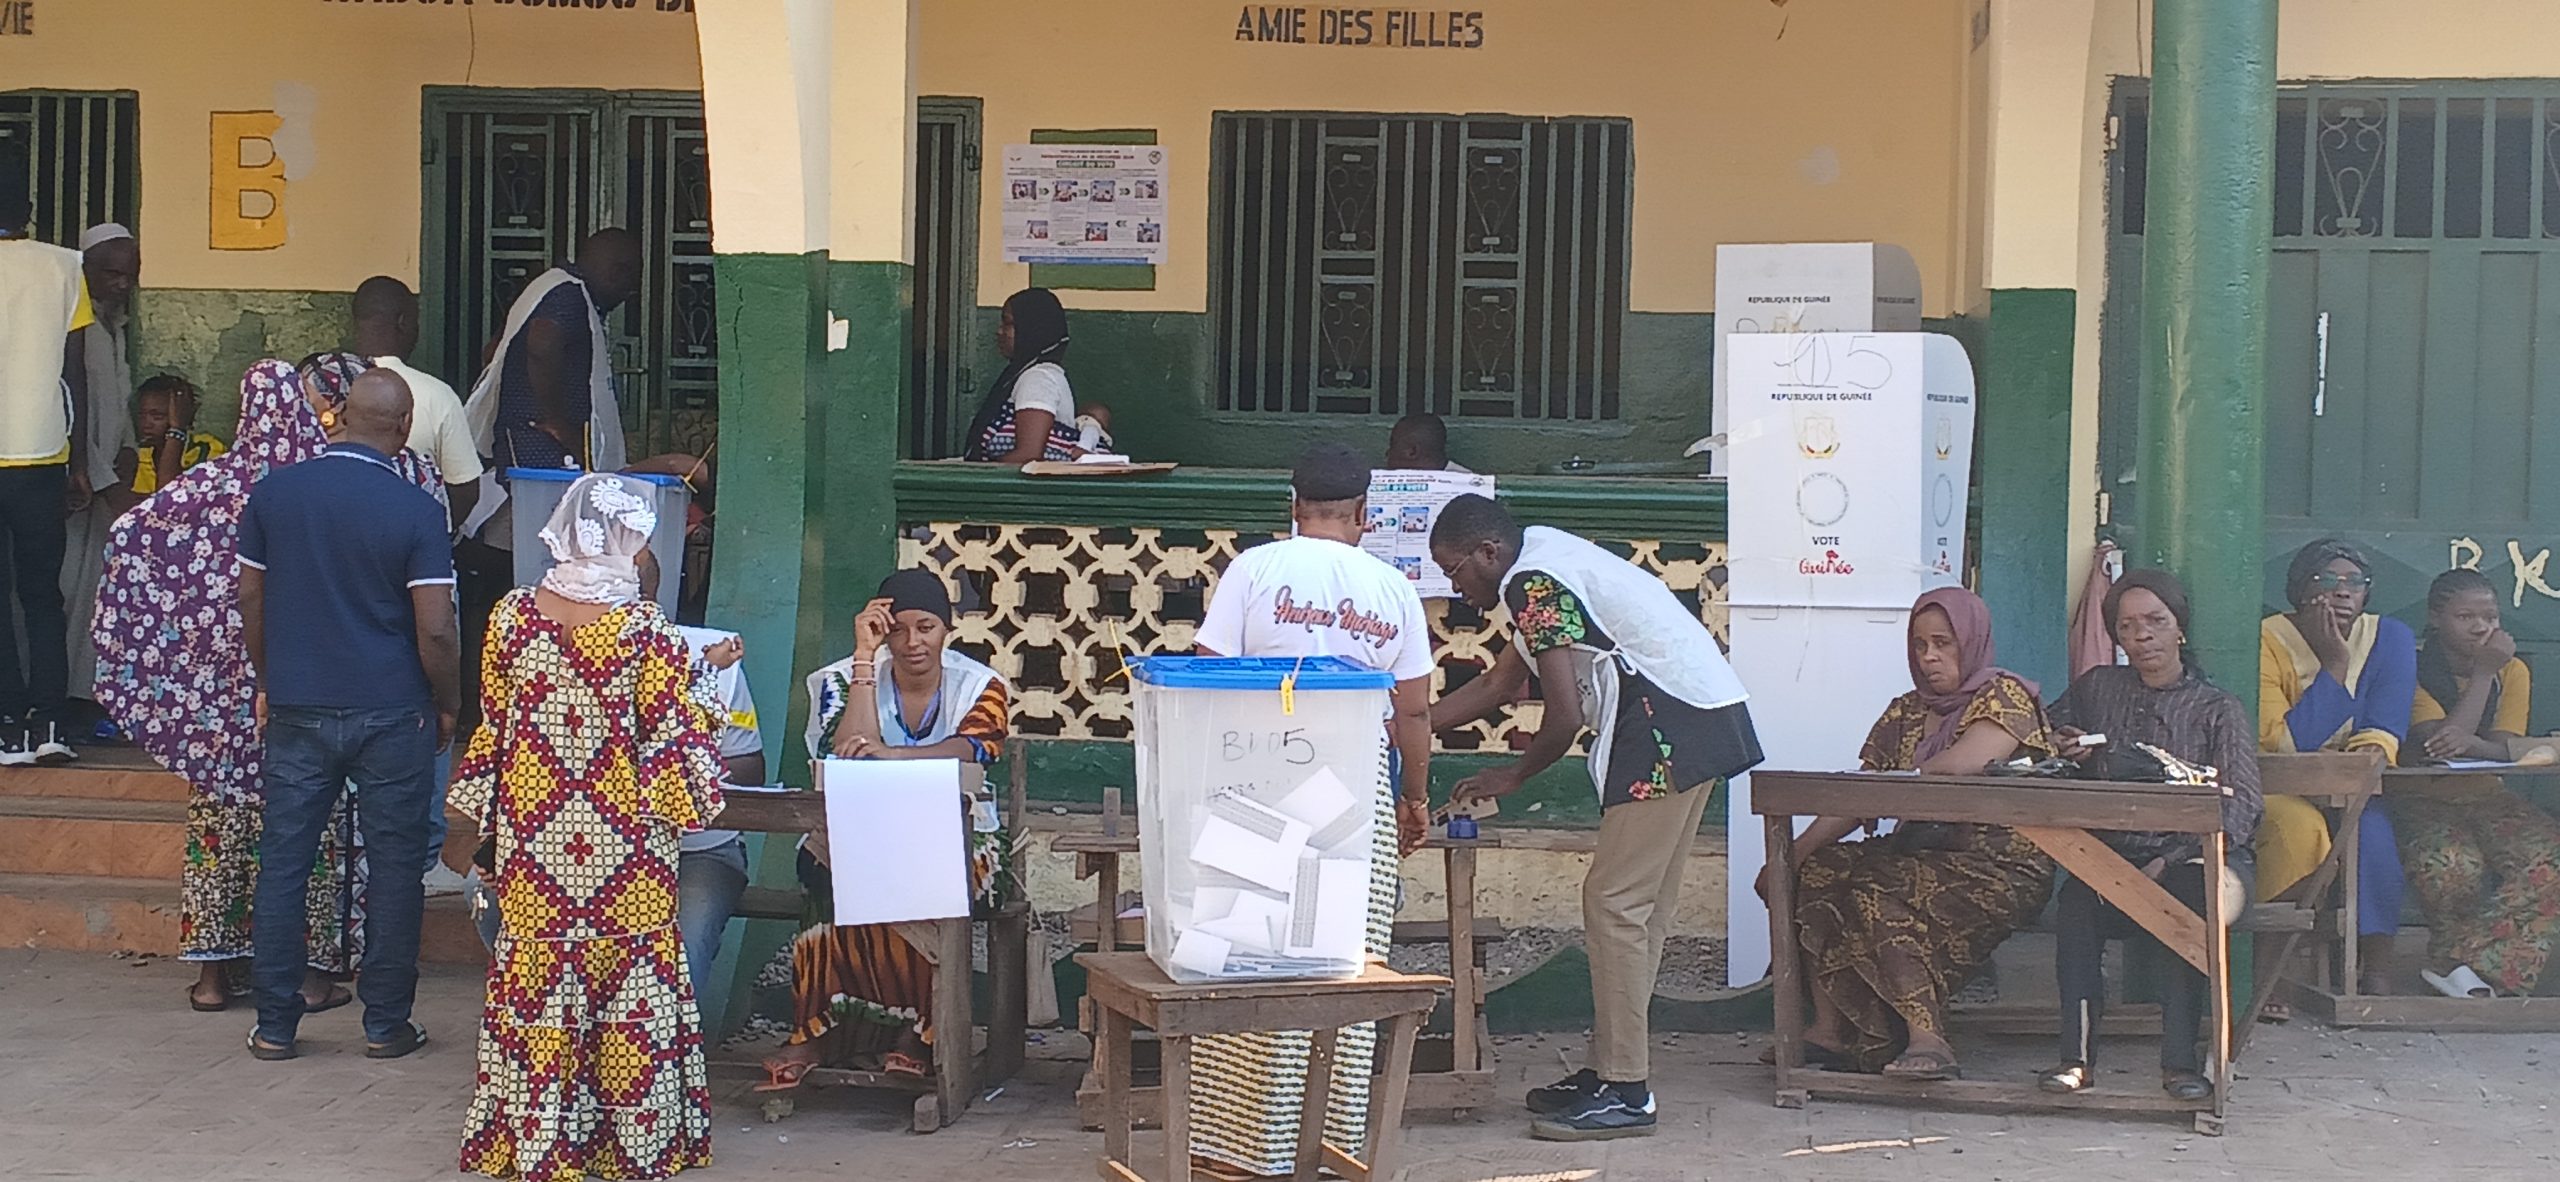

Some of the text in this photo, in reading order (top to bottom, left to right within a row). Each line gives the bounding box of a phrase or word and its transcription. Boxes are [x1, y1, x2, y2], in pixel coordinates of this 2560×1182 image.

[1235, 6, 1484, 48] AMIE DES FILLES
[209, 110, 287, 251] B
[1826, 393, 1837, 401] DE
[1812, 536, 1840, 545] VOTE
